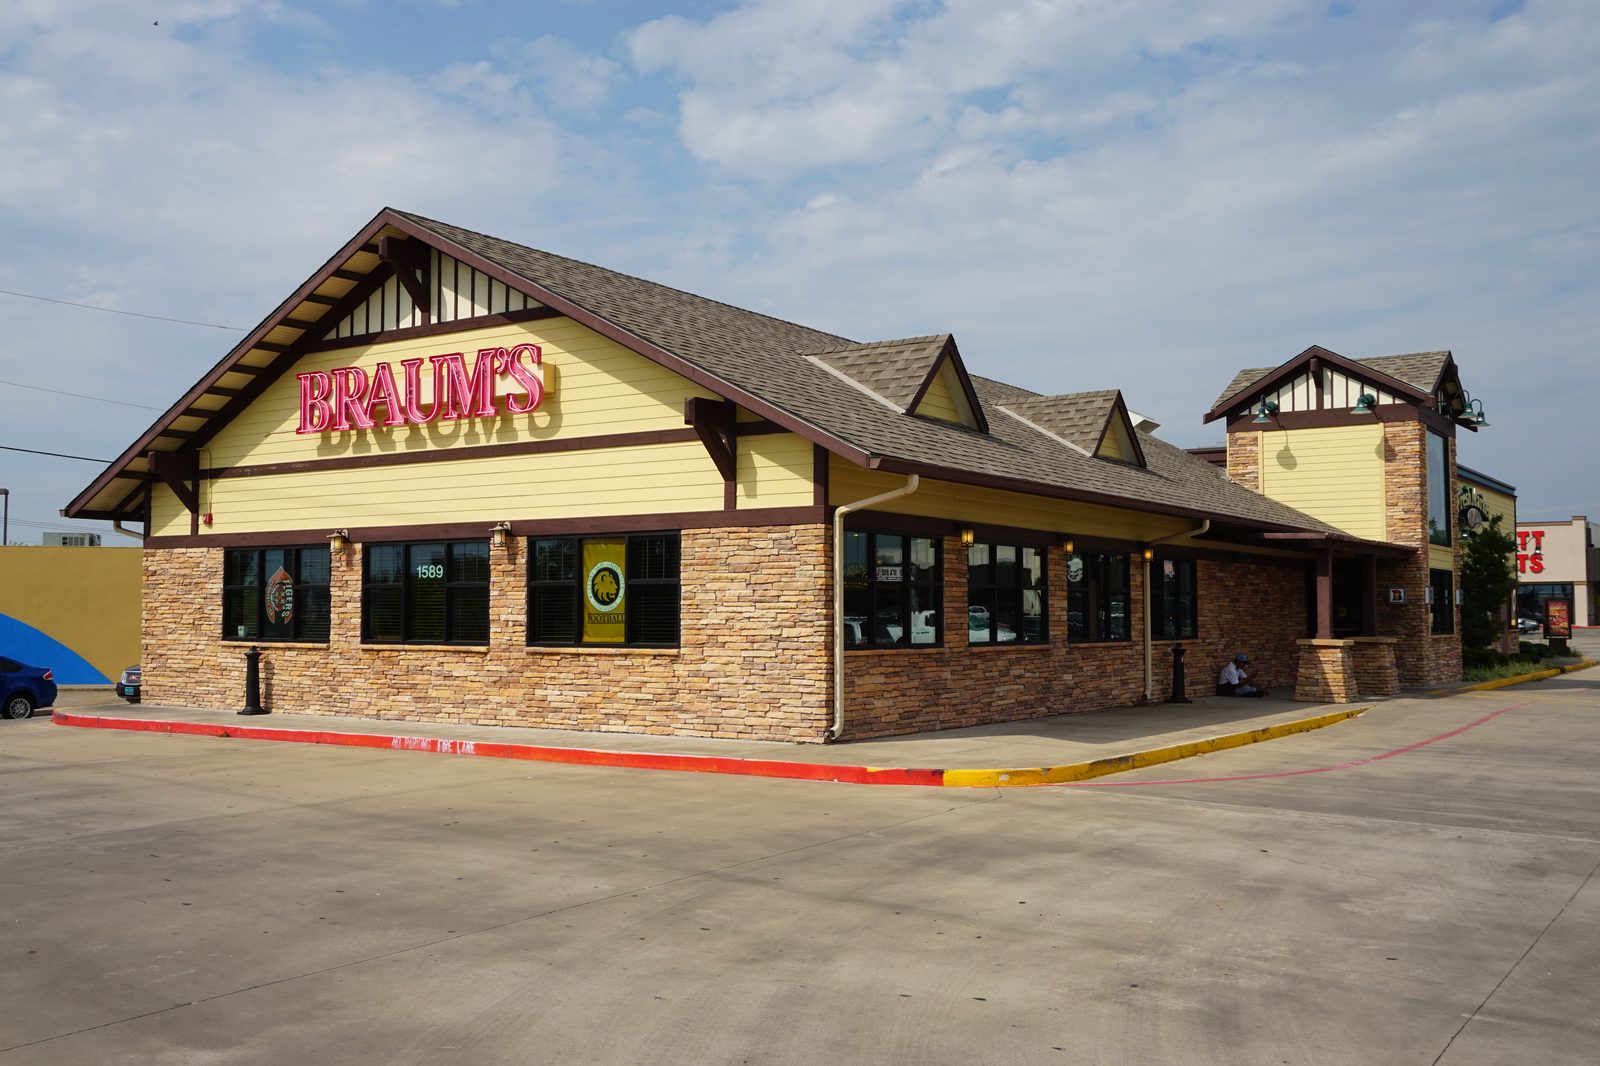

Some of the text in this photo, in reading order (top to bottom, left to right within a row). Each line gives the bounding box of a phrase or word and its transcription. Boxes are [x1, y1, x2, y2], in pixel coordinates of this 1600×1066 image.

[296, 344, 544, 434] BRAUM'S
[416, 565, 444, 579] 1589
[282, 580, 293, 617] TIGERS
[588, 614, 624, 623] FOOTBALL
[437, 739, 453, 753] FIRE
[457, 741, 475, 754] LANE
